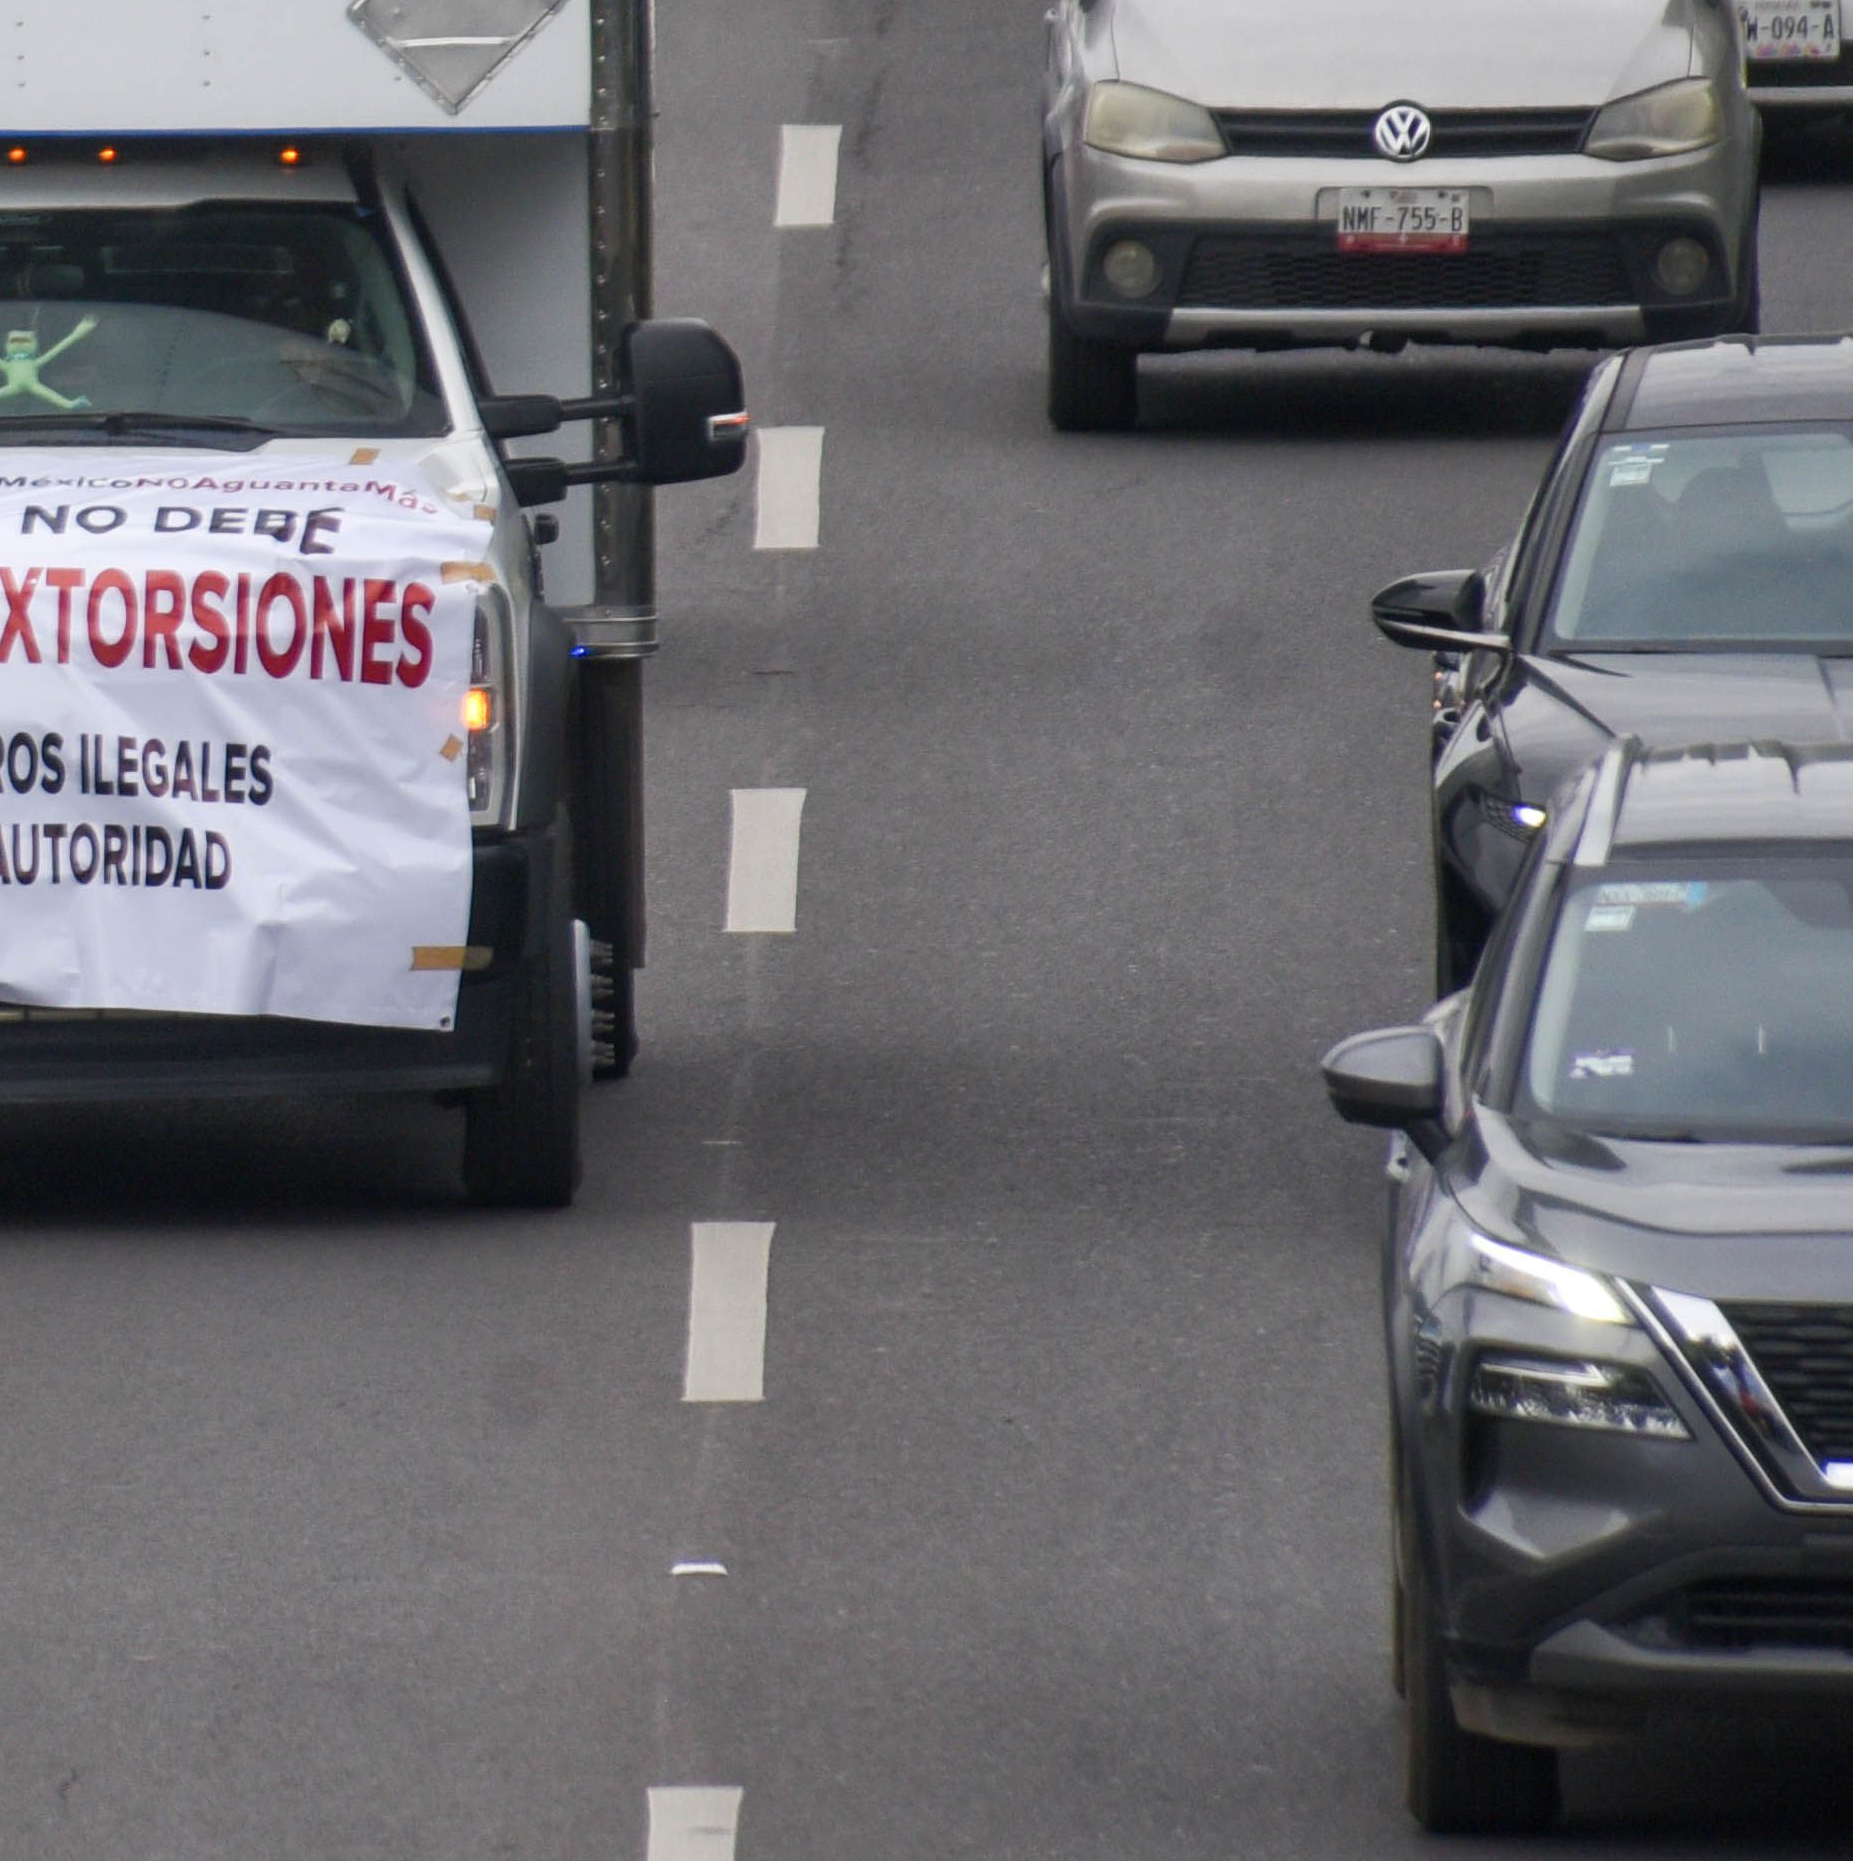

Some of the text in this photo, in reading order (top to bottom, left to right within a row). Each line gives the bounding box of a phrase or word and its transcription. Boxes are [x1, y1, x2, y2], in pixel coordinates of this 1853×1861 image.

[1343, 206, 1463, 232] NMF-755-B
[21, 503, 127, 535] NO
[154, 504, 344, 555] DEBE
[80, 732, 274, 807] ILEGALES
